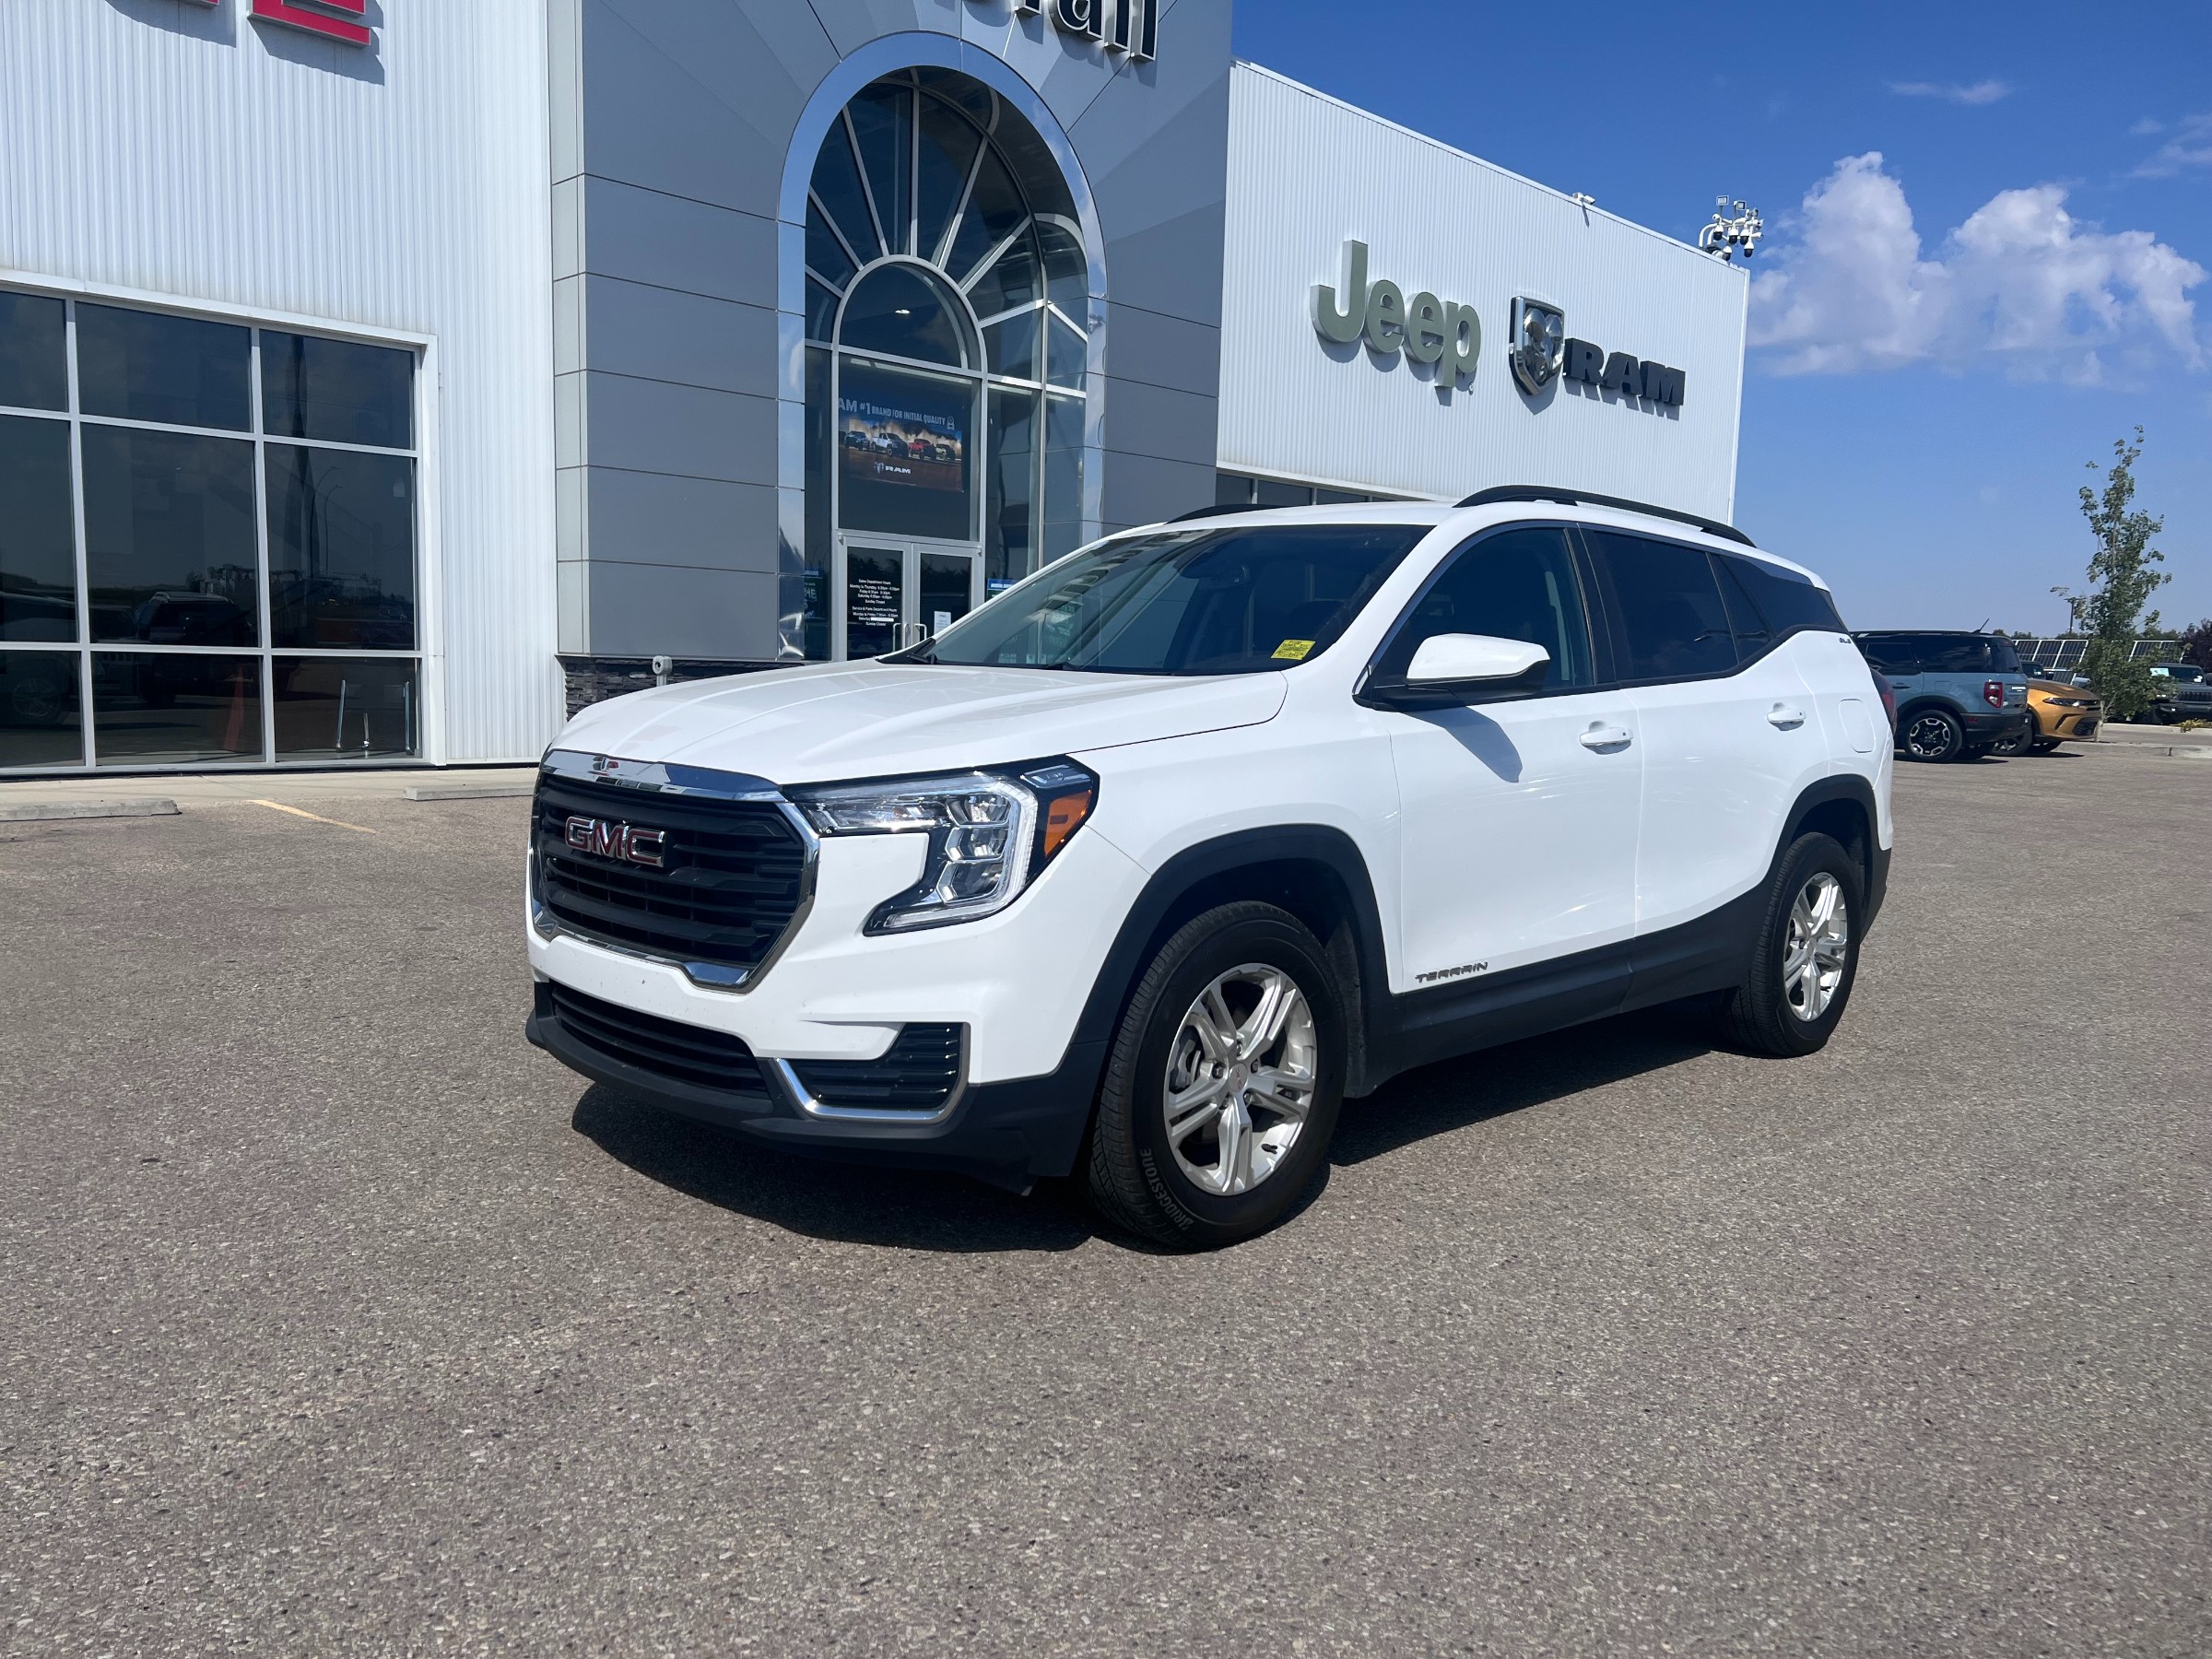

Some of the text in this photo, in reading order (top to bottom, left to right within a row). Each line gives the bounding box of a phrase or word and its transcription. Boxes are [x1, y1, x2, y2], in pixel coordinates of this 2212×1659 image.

[1310, 239, 1481, 389] Jeep
[1563, 337, 1686, 406] RAM
[839, 398, 857, 413] AM
[871, 406, 891, 418] BRAND
[892, 408, 903, 419] FOR
[904, 411, 923, 422] INITIAL
[924, 414, 947, 426] QUALITY
[885, 465, 911, 475] RAM
[565, 816, 665, 867] GMC
[1415, 961, 1488, 983] TERRAIN
[1139, 1147, 1194, 1231] BRIDGESTONE
